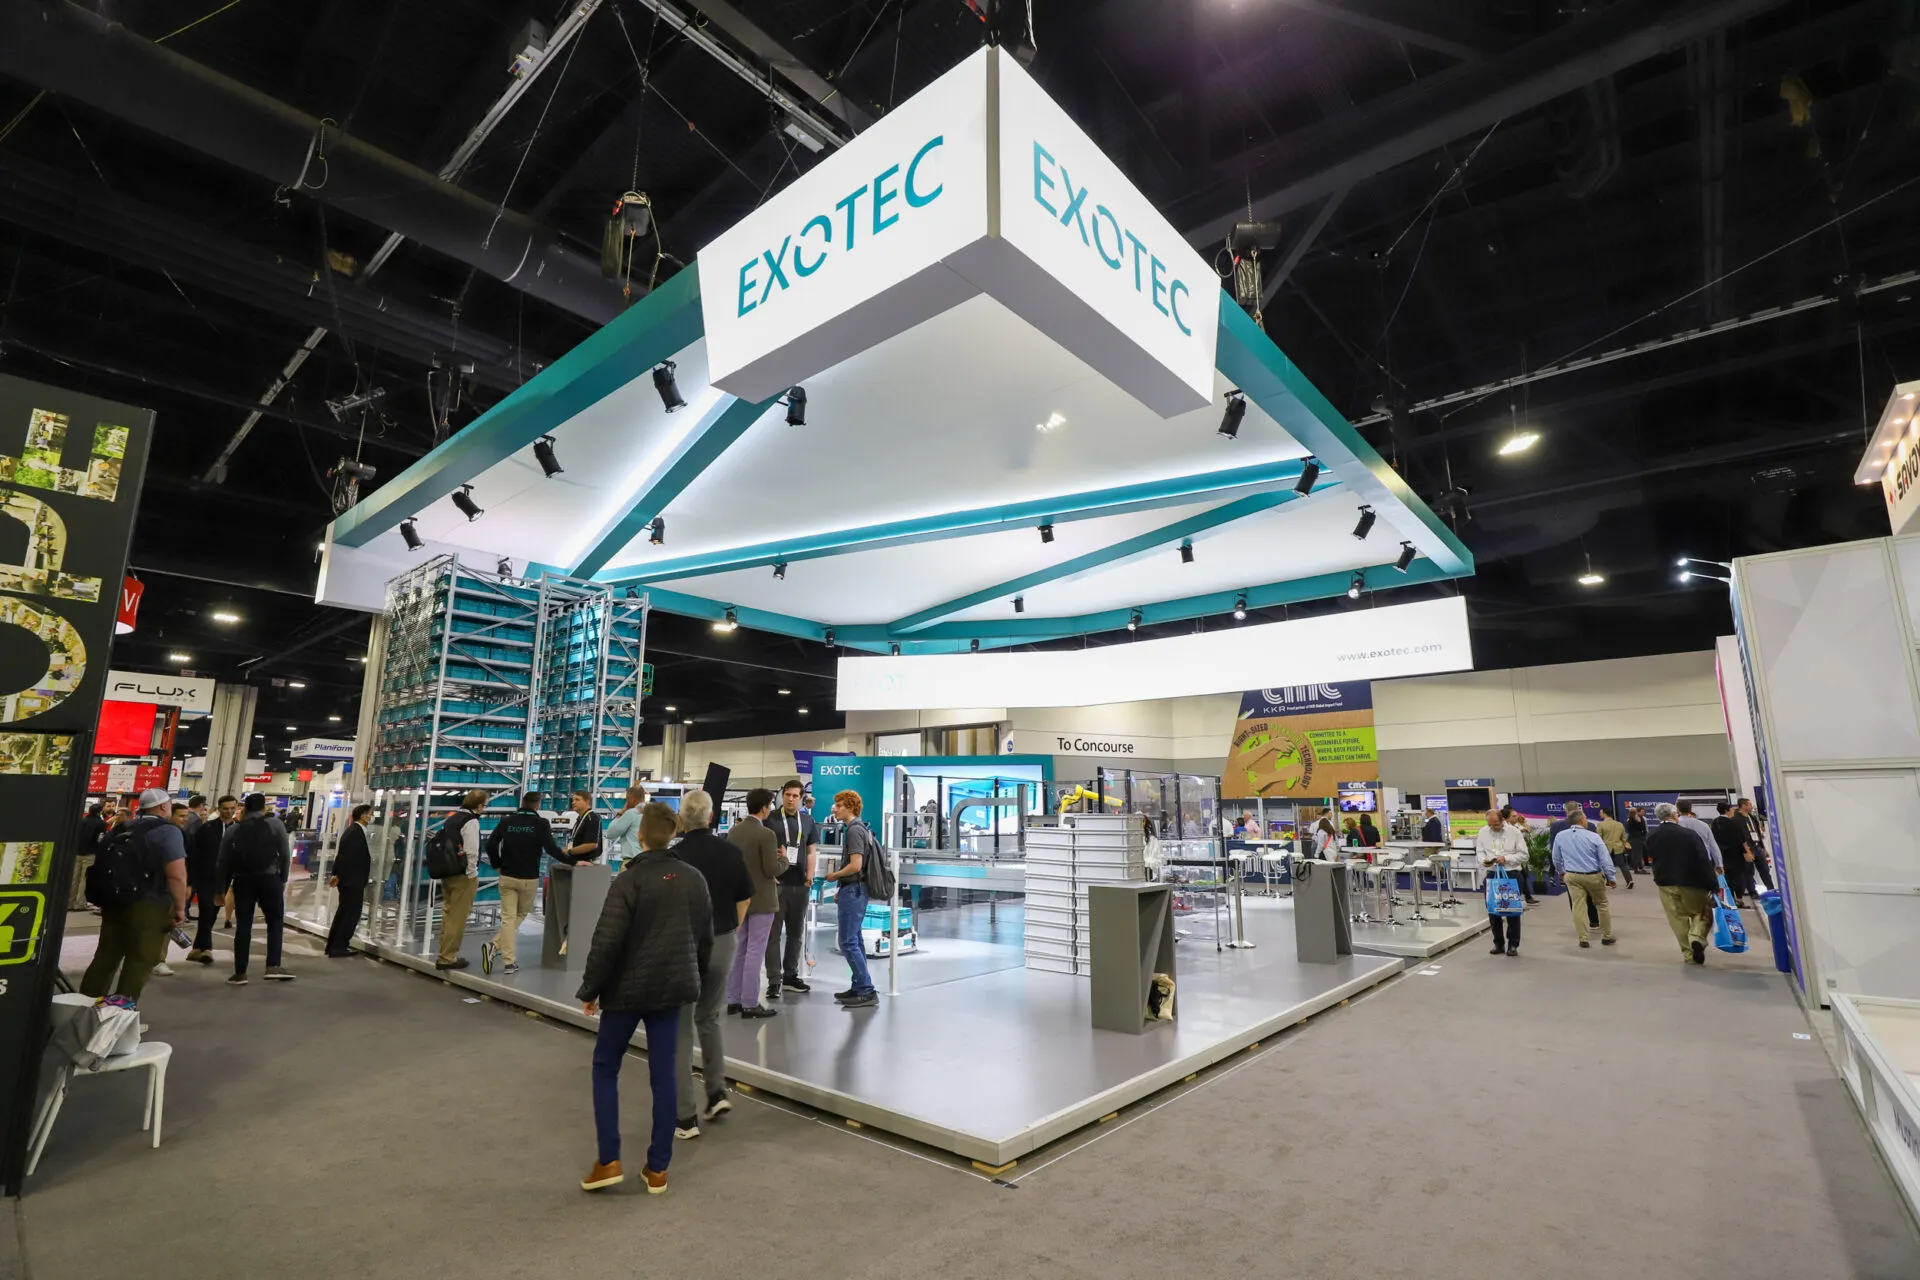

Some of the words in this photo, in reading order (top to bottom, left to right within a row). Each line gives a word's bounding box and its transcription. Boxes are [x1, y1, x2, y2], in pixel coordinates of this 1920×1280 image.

[737, 135, 944, 318] EXOTEC
[1033, 140, 1192, 336] EXOTEC
[1337, 643, 1442, 661] www.exotec.com
[115, 683, 196, 698] FLUX
[1263, 706, 1286, 714] KKR
[314, 743, 353, 753] Planiform
[1057, 737, 1071, 751] To
[1074, 739, 1134, 753] Concourse
[1233, 723, 1268, 748] RIGHT-SIZED
[1300, 745, 1313, 790] TECHNOLOGY
[820, 765, 860, 775] EXOTEC
[507, 825, 535, 833] EXOTEC
